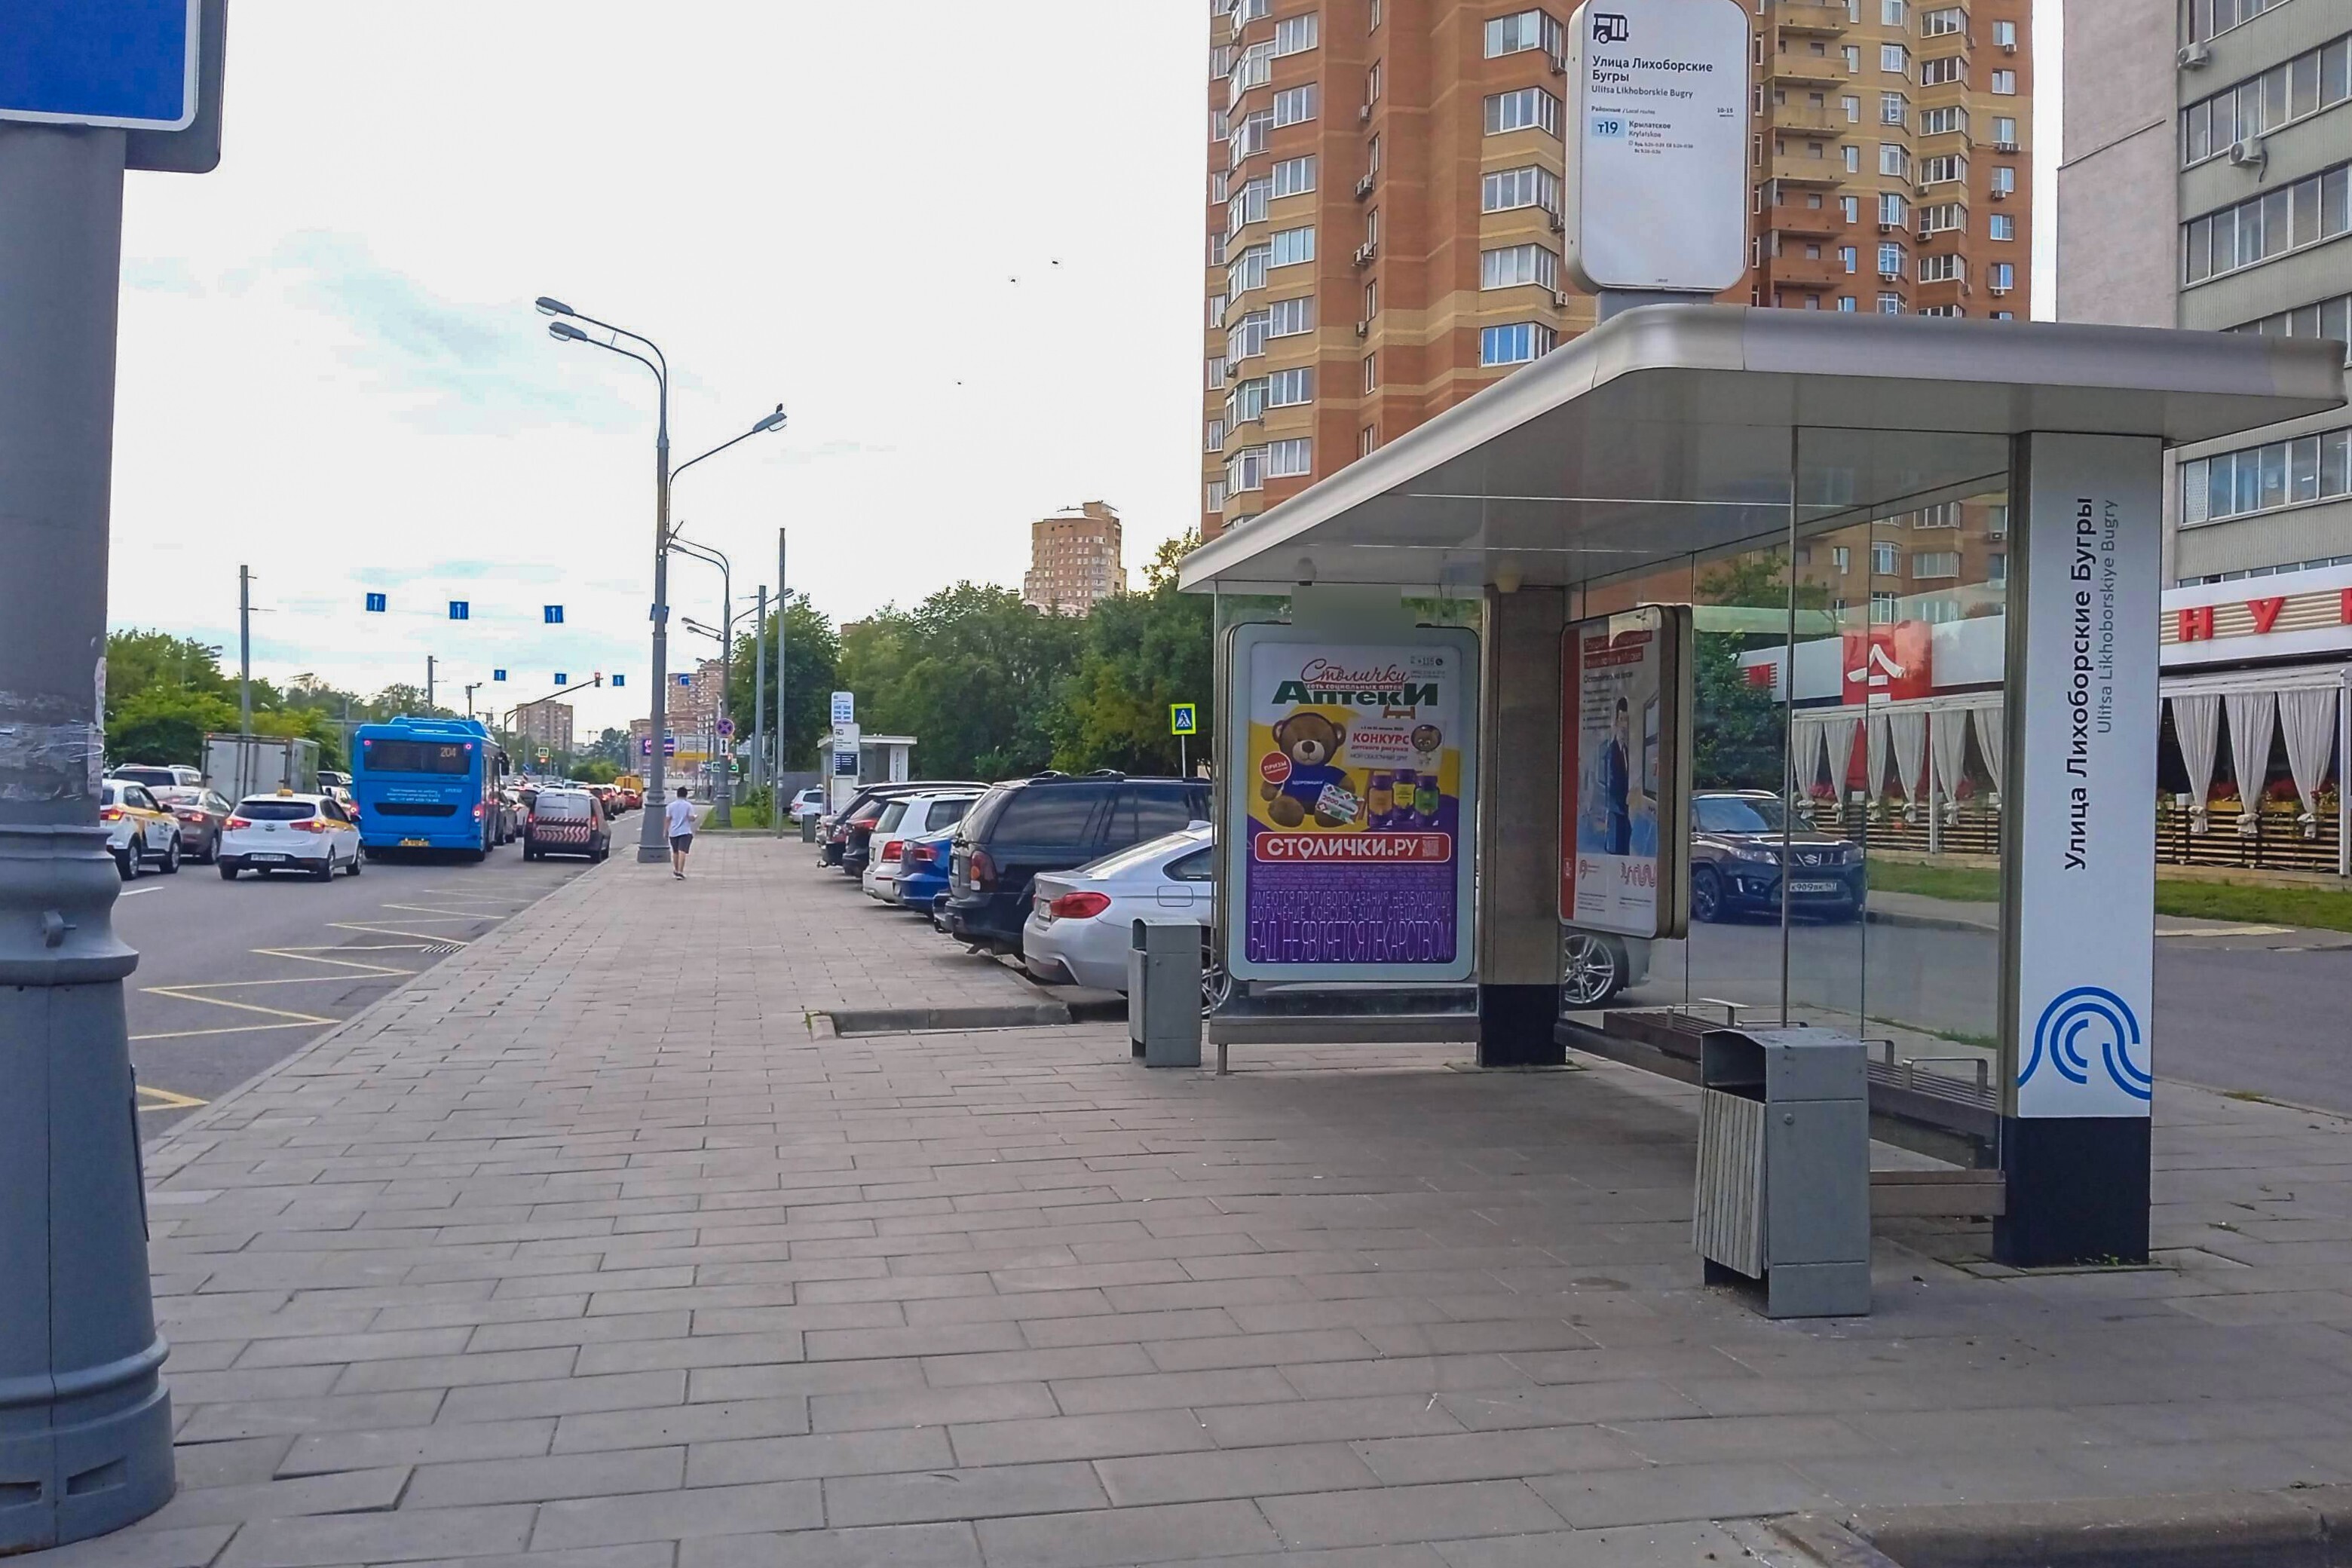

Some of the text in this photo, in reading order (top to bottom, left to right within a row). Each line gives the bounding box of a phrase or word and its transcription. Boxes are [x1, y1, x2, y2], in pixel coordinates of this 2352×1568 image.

[1593, 55, 1713, 73] Улица Лихоборские
[1592, 69, 1629, 83] Бугры
[1591, 85, 1693, 99] Ulitsa Likhoborskie Bugry
[1628, 121, 1671, 130] Крылатское
[2097, 500, 2118, 733] Ulitsa Likhoborskiye Bugry
[1301, 658, 1412, 682] Столички
[2065, 498, 2096, 871] Улица Лихоборские Бугры
[1353, 733, 1410, 745] КОНКУРС
[440, 747, 456, 758] 204
[1267, 838, 1418, 859] СТОЛИЧКИ.РУ
[1252, 891, 1294, 905] ИМЕЮТСЯ
[1393, 892, 1451, 905] НЕОБХОДИМО
[1252, 906, 1451, 920] ПОЛУЧЕНИЕ КОНСУЛЬТАЦИИ СПЕЦИАЛИСТА
[1283, 921, 1298, 961] НЕ
[1301, 921, 1364, 961] ЯВЛЯЕТСЯ
[1367, 921, 1451, 961] ЛЕКАРСТВОМ
